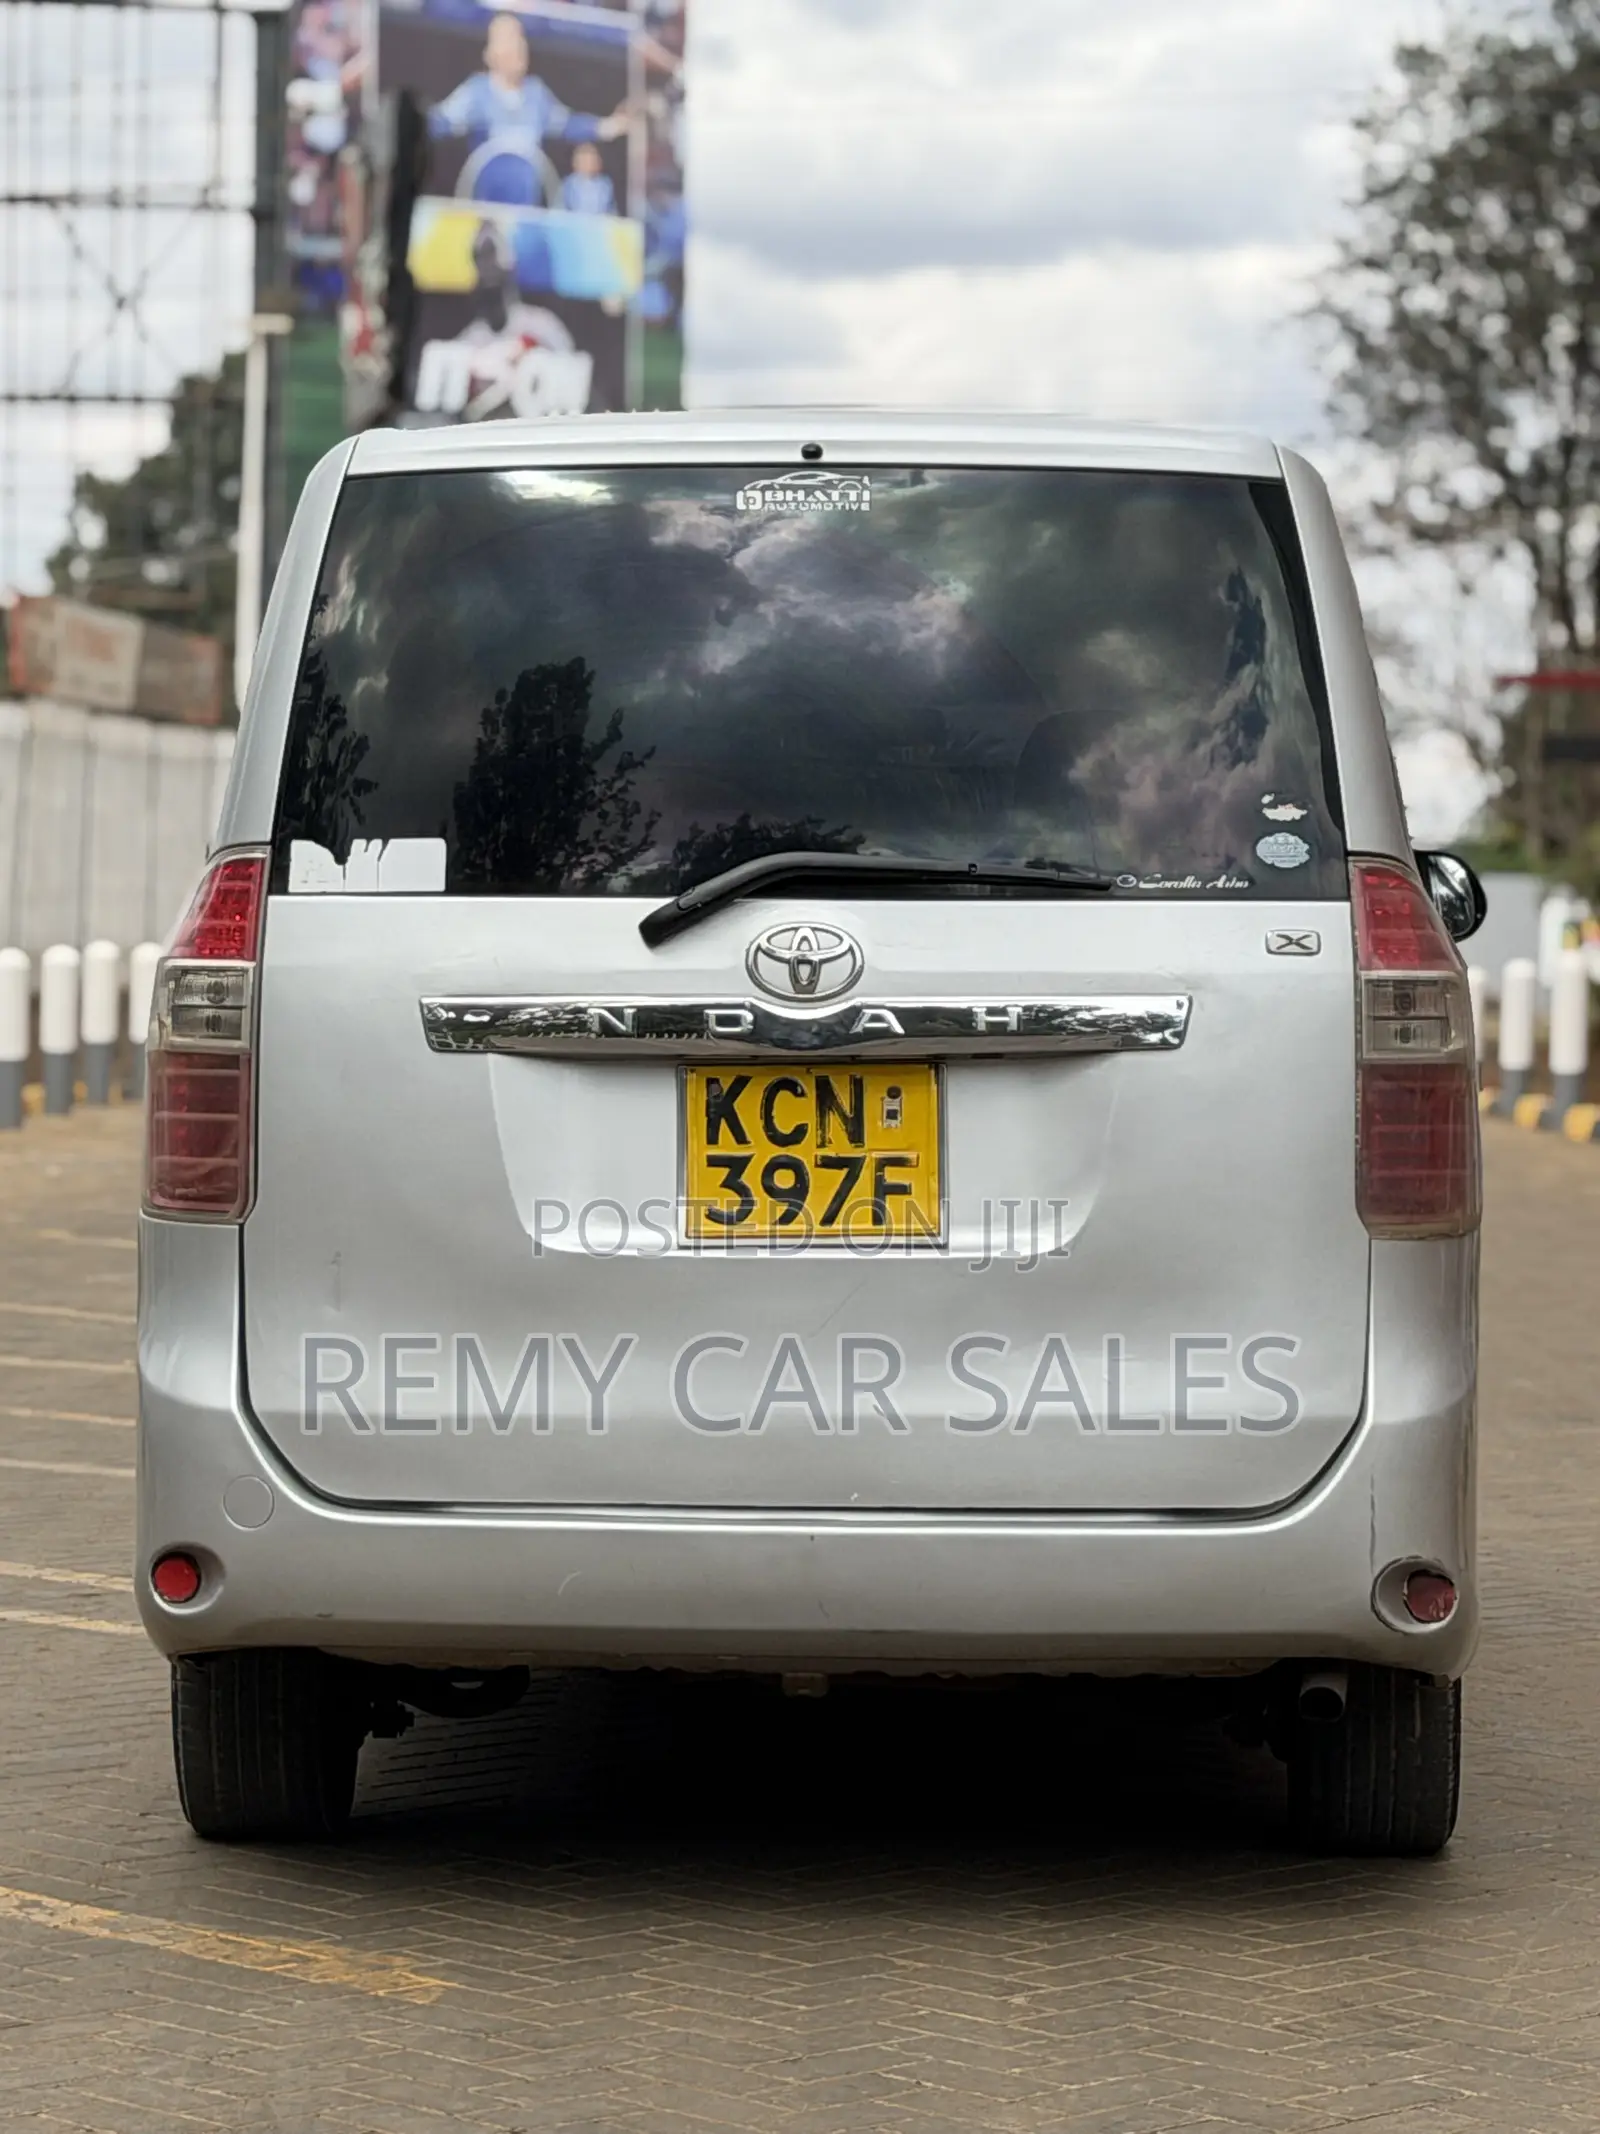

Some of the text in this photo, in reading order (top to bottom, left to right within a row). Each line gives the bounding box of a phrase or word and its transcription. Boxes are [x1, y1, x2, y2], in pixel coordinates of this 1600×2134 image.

[764, 490, 871, 501] BHATTI
[764, 502, 871, 511] AUTOMOTIVE
[1275, 933, 1313, 951] X
[705, 1074, 866, 1149] KCN
[704, 1152, 920, 1228] 397F
